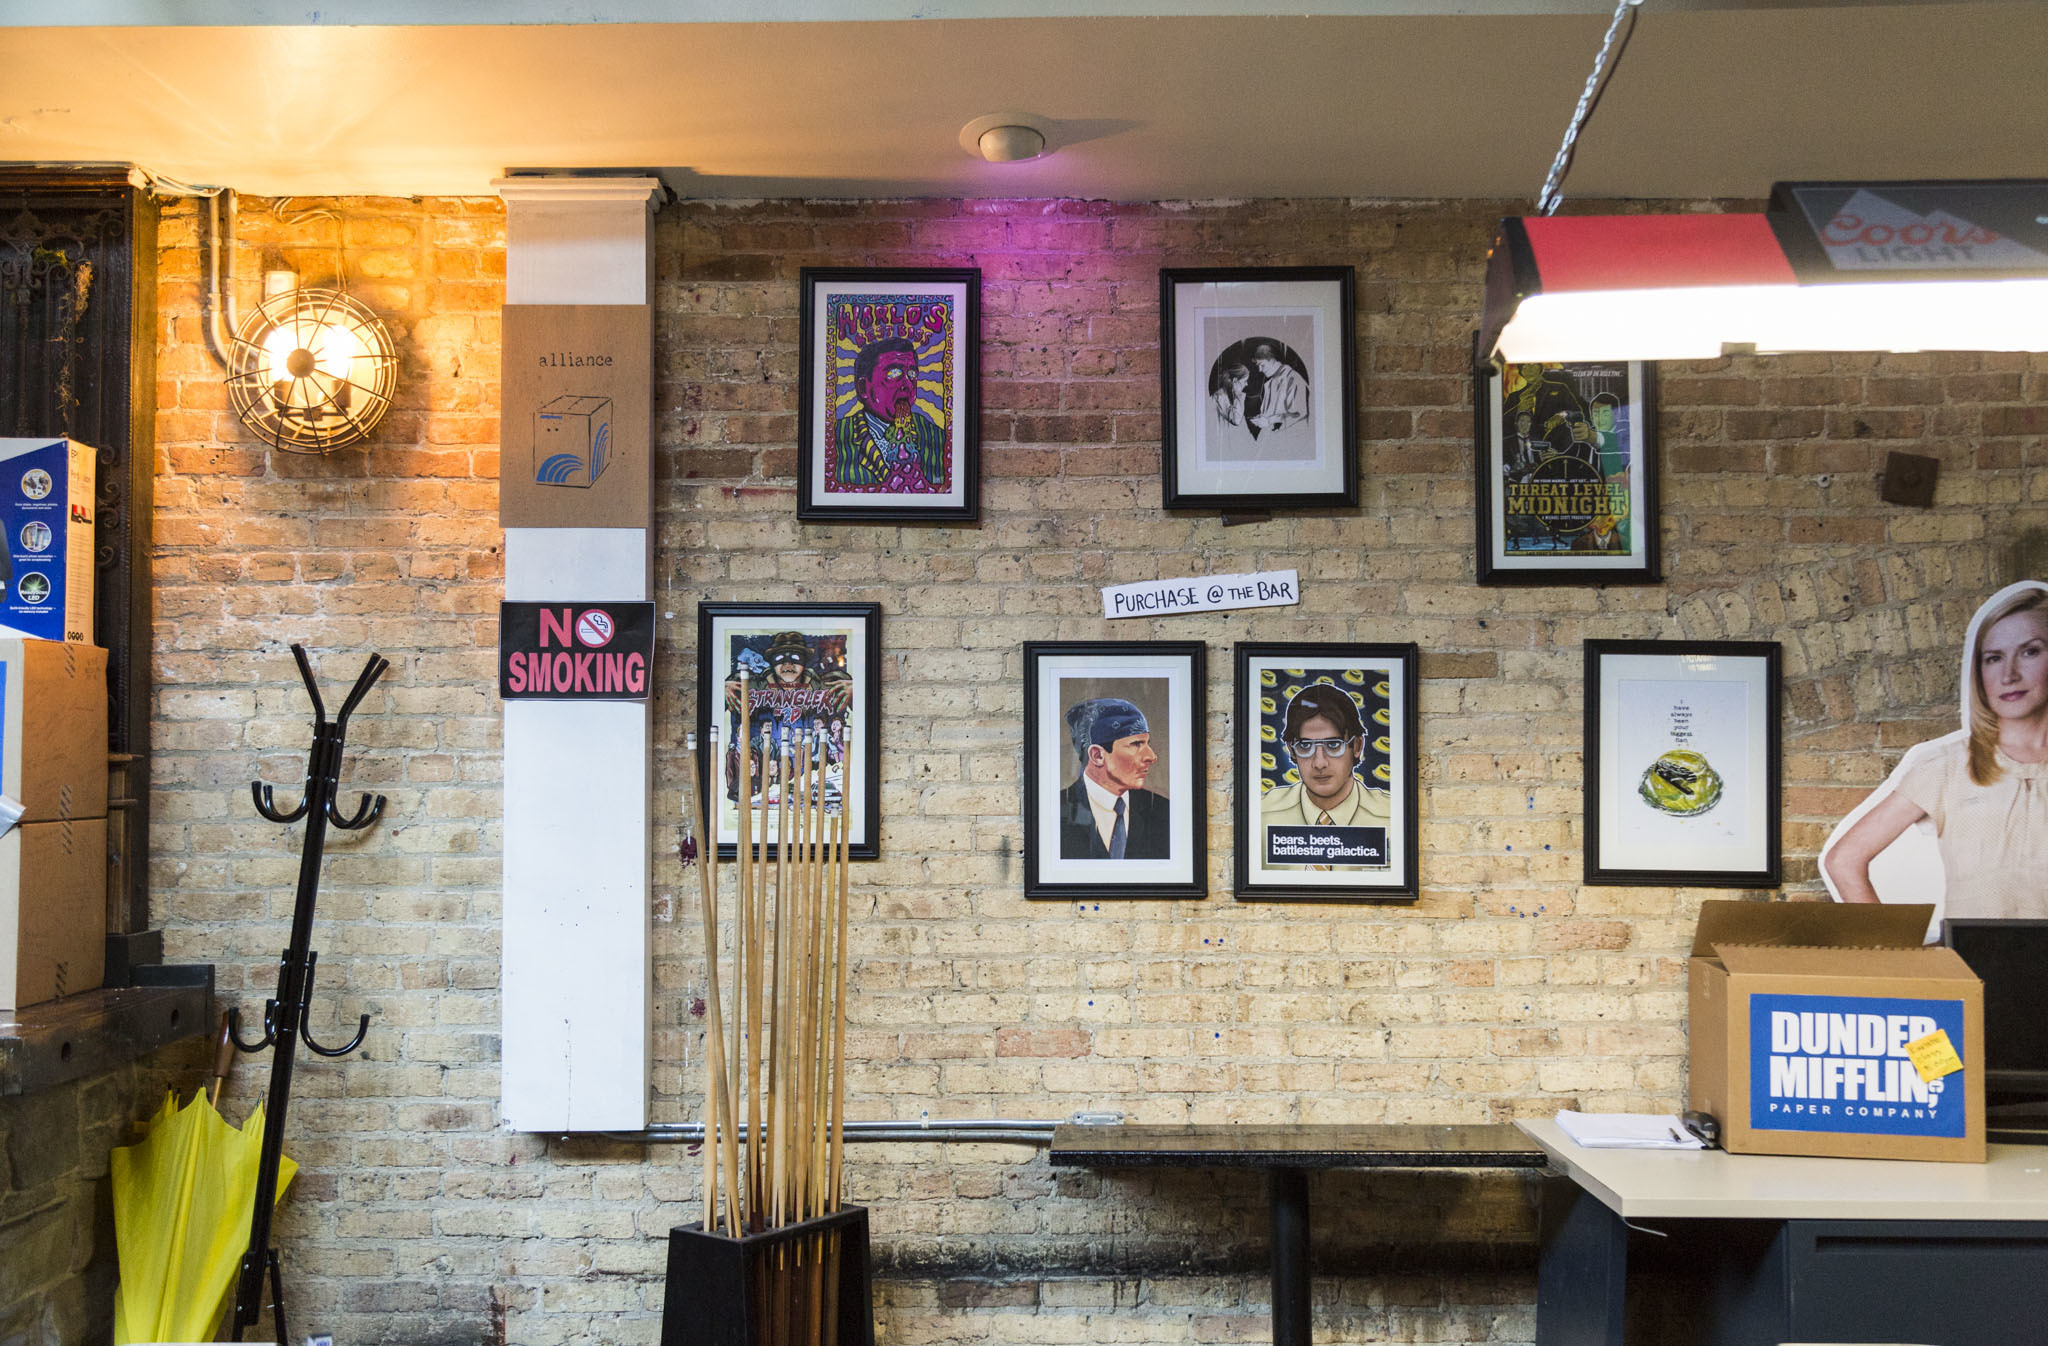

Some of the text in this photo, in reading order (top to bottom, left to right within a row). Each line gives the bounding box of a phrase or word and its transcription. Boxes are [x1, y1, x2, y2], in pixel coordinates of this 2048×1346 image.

[1820, 214, 2003, 247] Coors
[1856, 245, 1975, 262] LIGHT
[855, 325, 933, 349] BEST BOSS
[539, 351, 613, 367] alliance
[1509, 483, 1624, 496] THREAT LEVEL
[1507, 496, 1625, 515] MIDNIGHT
[1114, 581, 1294, 614] PURCHASE @ THE BAR
[508, 651, 645, 693] SMOKING
[748, 688, 835, 716] STRANGLER
[782, 706, 803, 725] 3D
[1272, 834, 1344, 846] bears. beets.
[1272, 845, 1380, 859] battlestar galactica.
[1769, 1103, 1938, 1119] PAPER COMPANY
